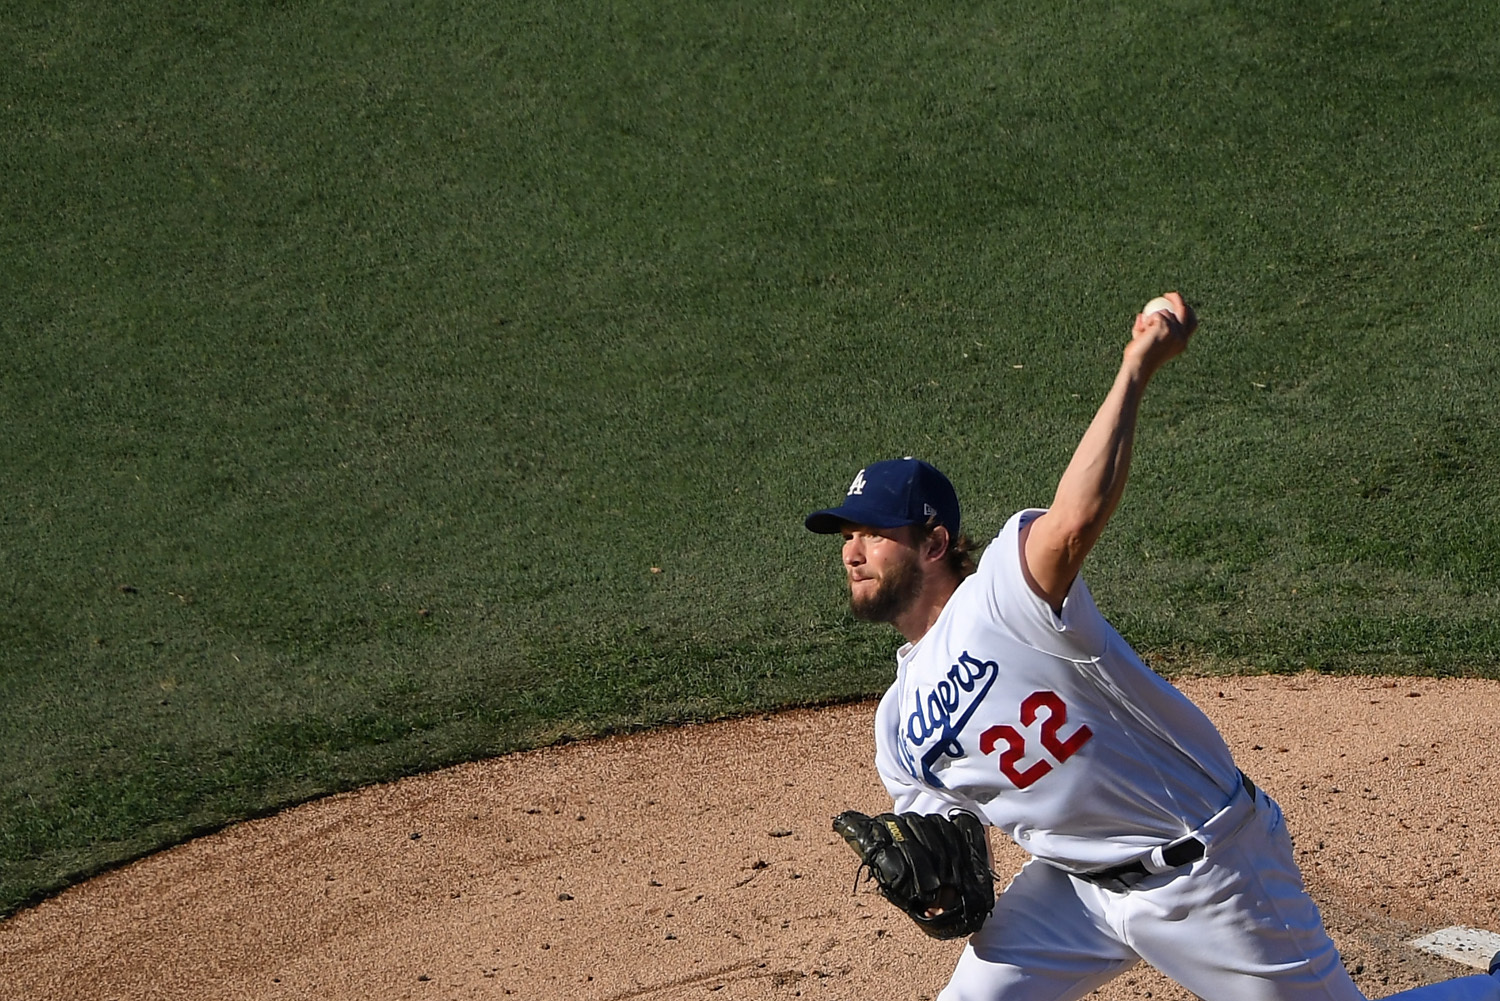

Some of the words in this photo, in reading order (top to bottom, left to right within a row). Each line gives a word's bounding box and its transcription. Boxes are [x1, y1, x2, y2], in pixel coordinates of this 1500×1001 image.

[847, 469, 867, 496] LA
[897, 650, 999, 788] dgers
[978, 689, 1093, 790] 22
